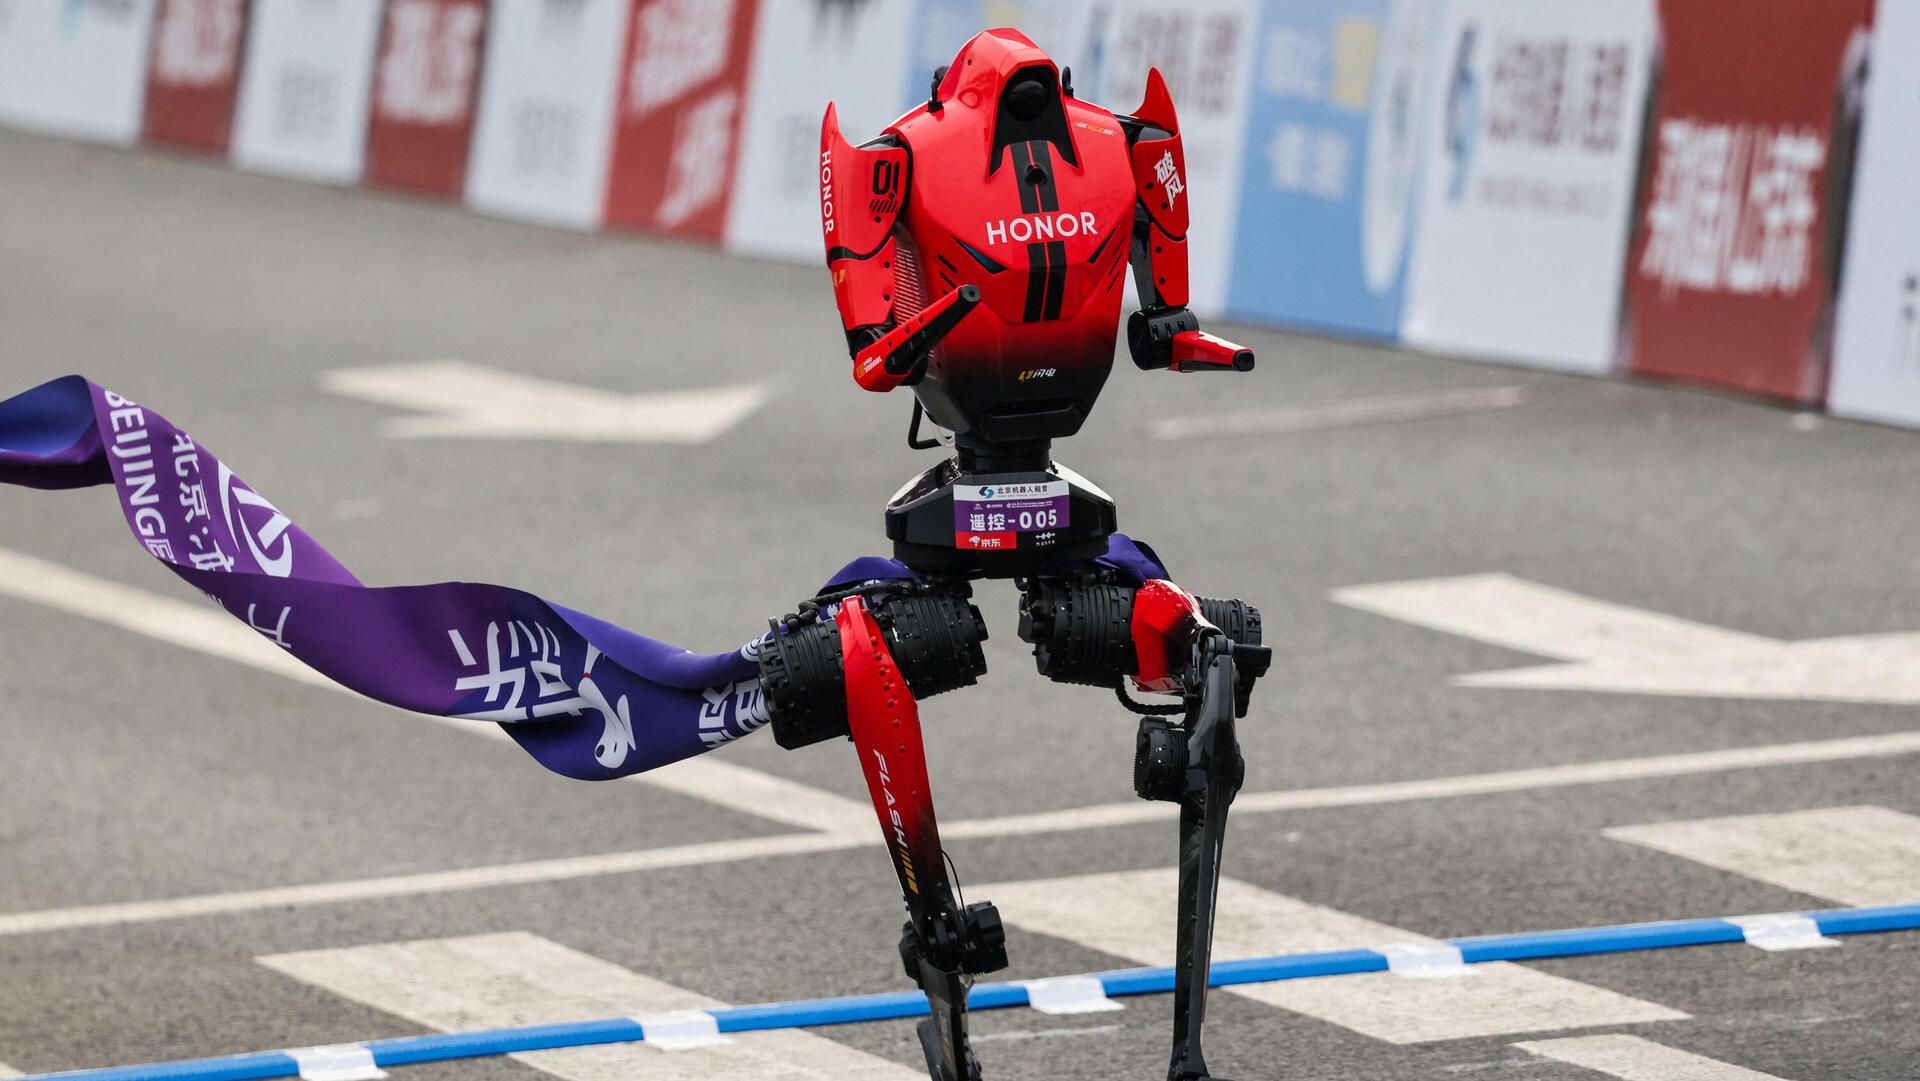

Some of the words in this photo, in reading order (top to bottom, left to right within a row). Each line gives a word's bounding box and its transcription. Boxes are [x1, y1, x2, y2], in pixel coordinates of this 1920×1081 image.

[822, 150, 835, 234] HONOR
[1154, 149, 1185, 213] 破风
[986, 211, 1098, 245] HONOR
[997, 485, 1048, 495] 北京机器人租赁
[969, 509, 1057, 532] 遥控-005
[981, 538, 1001, 548] 京东
[873, 749, 908, 849] FLASH
